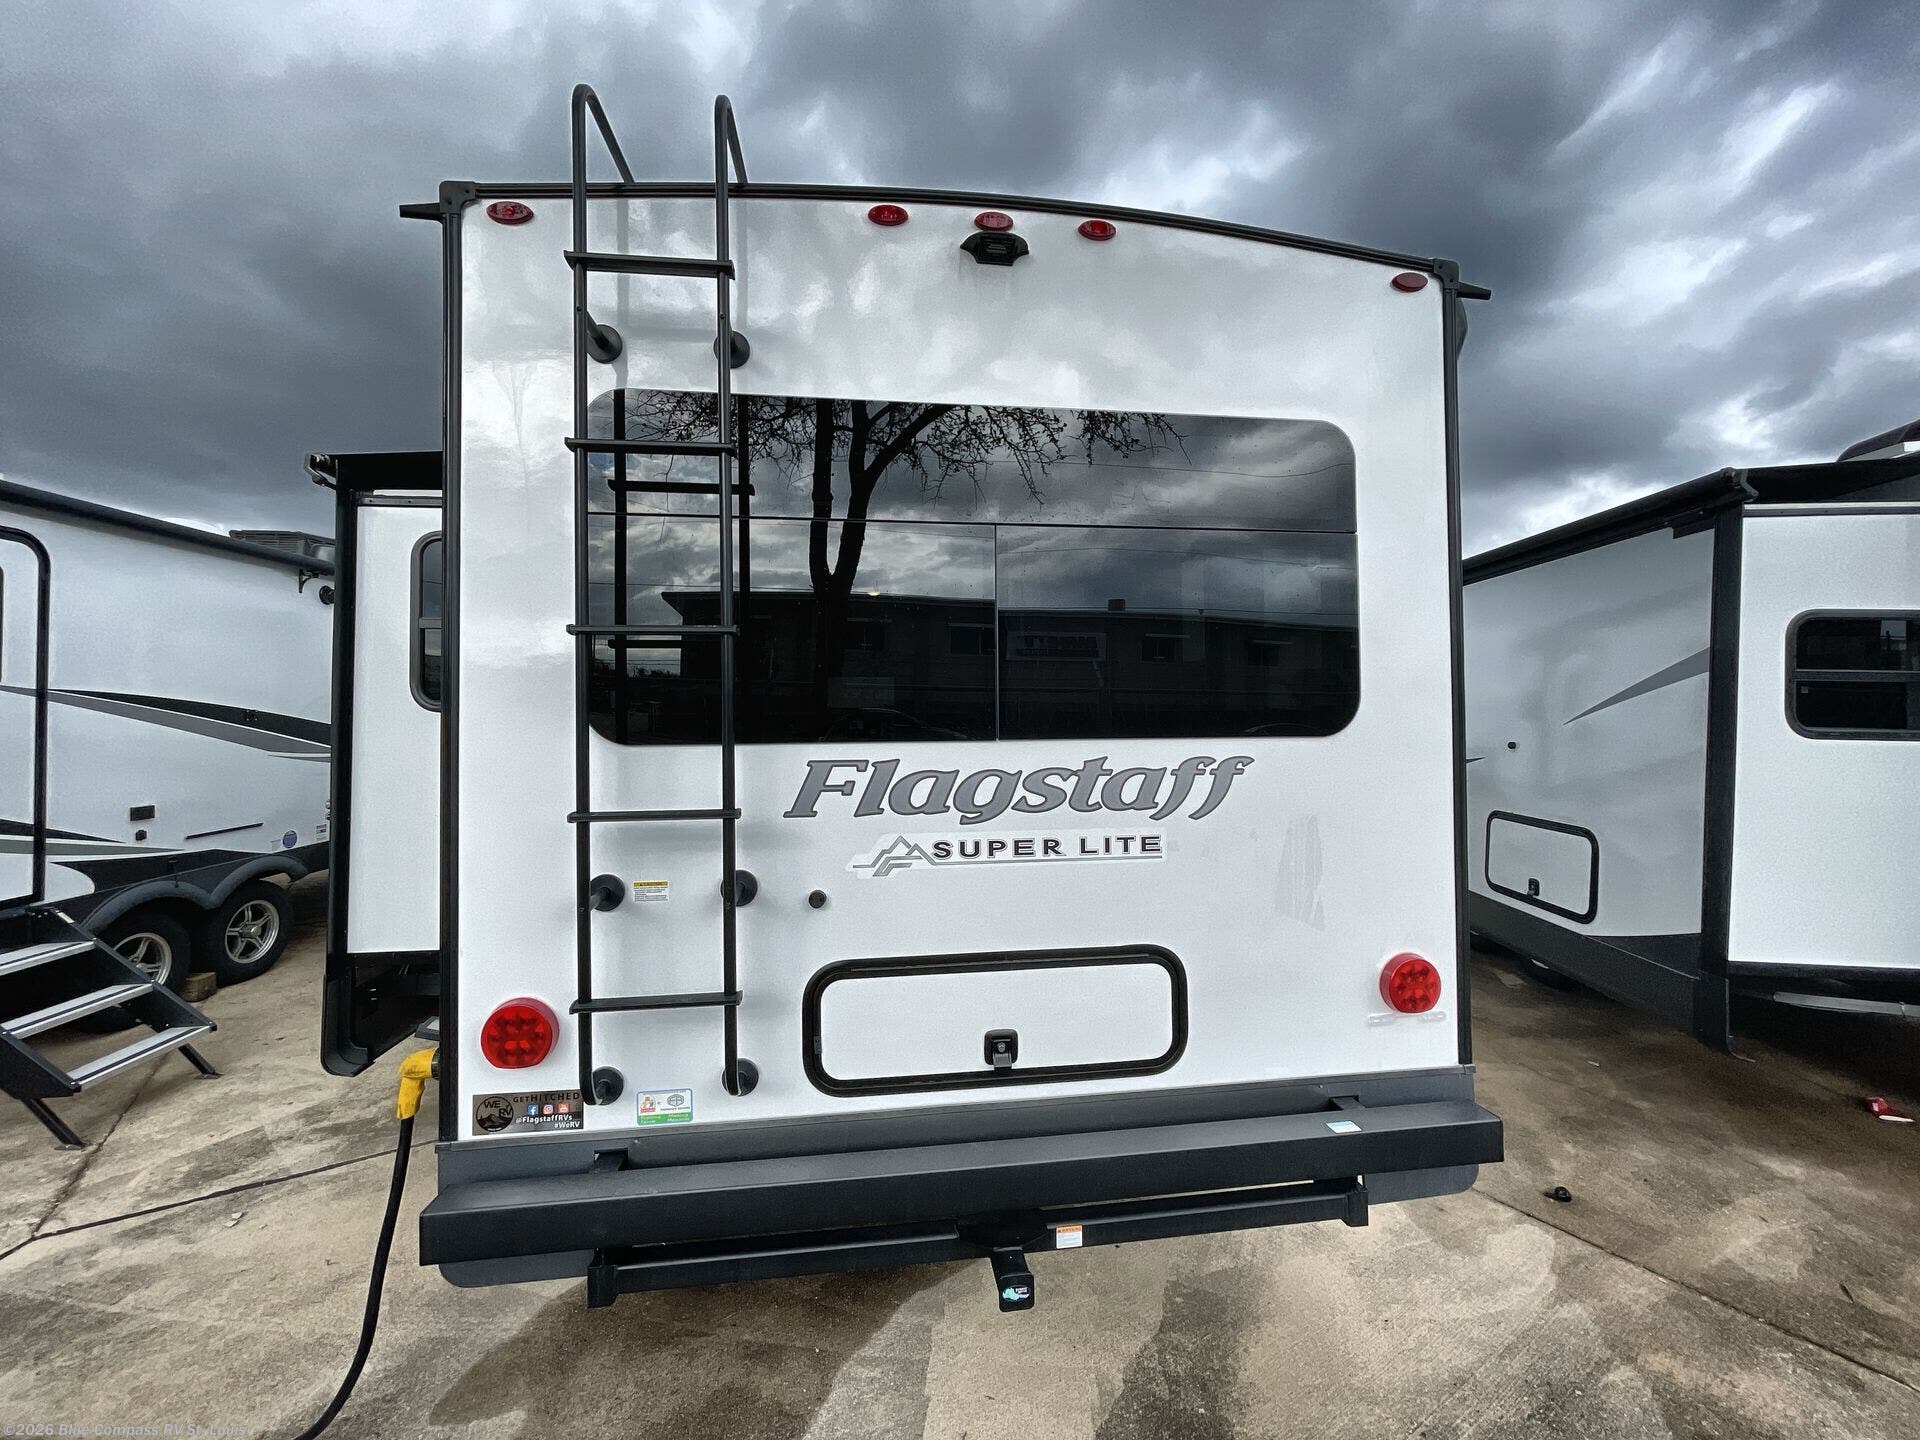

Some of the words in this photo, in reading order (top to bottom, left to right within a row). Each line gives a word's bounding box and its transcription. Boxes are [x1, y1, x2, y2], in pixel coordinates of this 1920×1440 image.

[783, 755, 1255, 825] Flagstaff
[932, 837, 1067, 859] SUPER
[1079, 834, 1162, 856] LITE
[516, 1114, 573, 1124] @FlagstaffRVs
